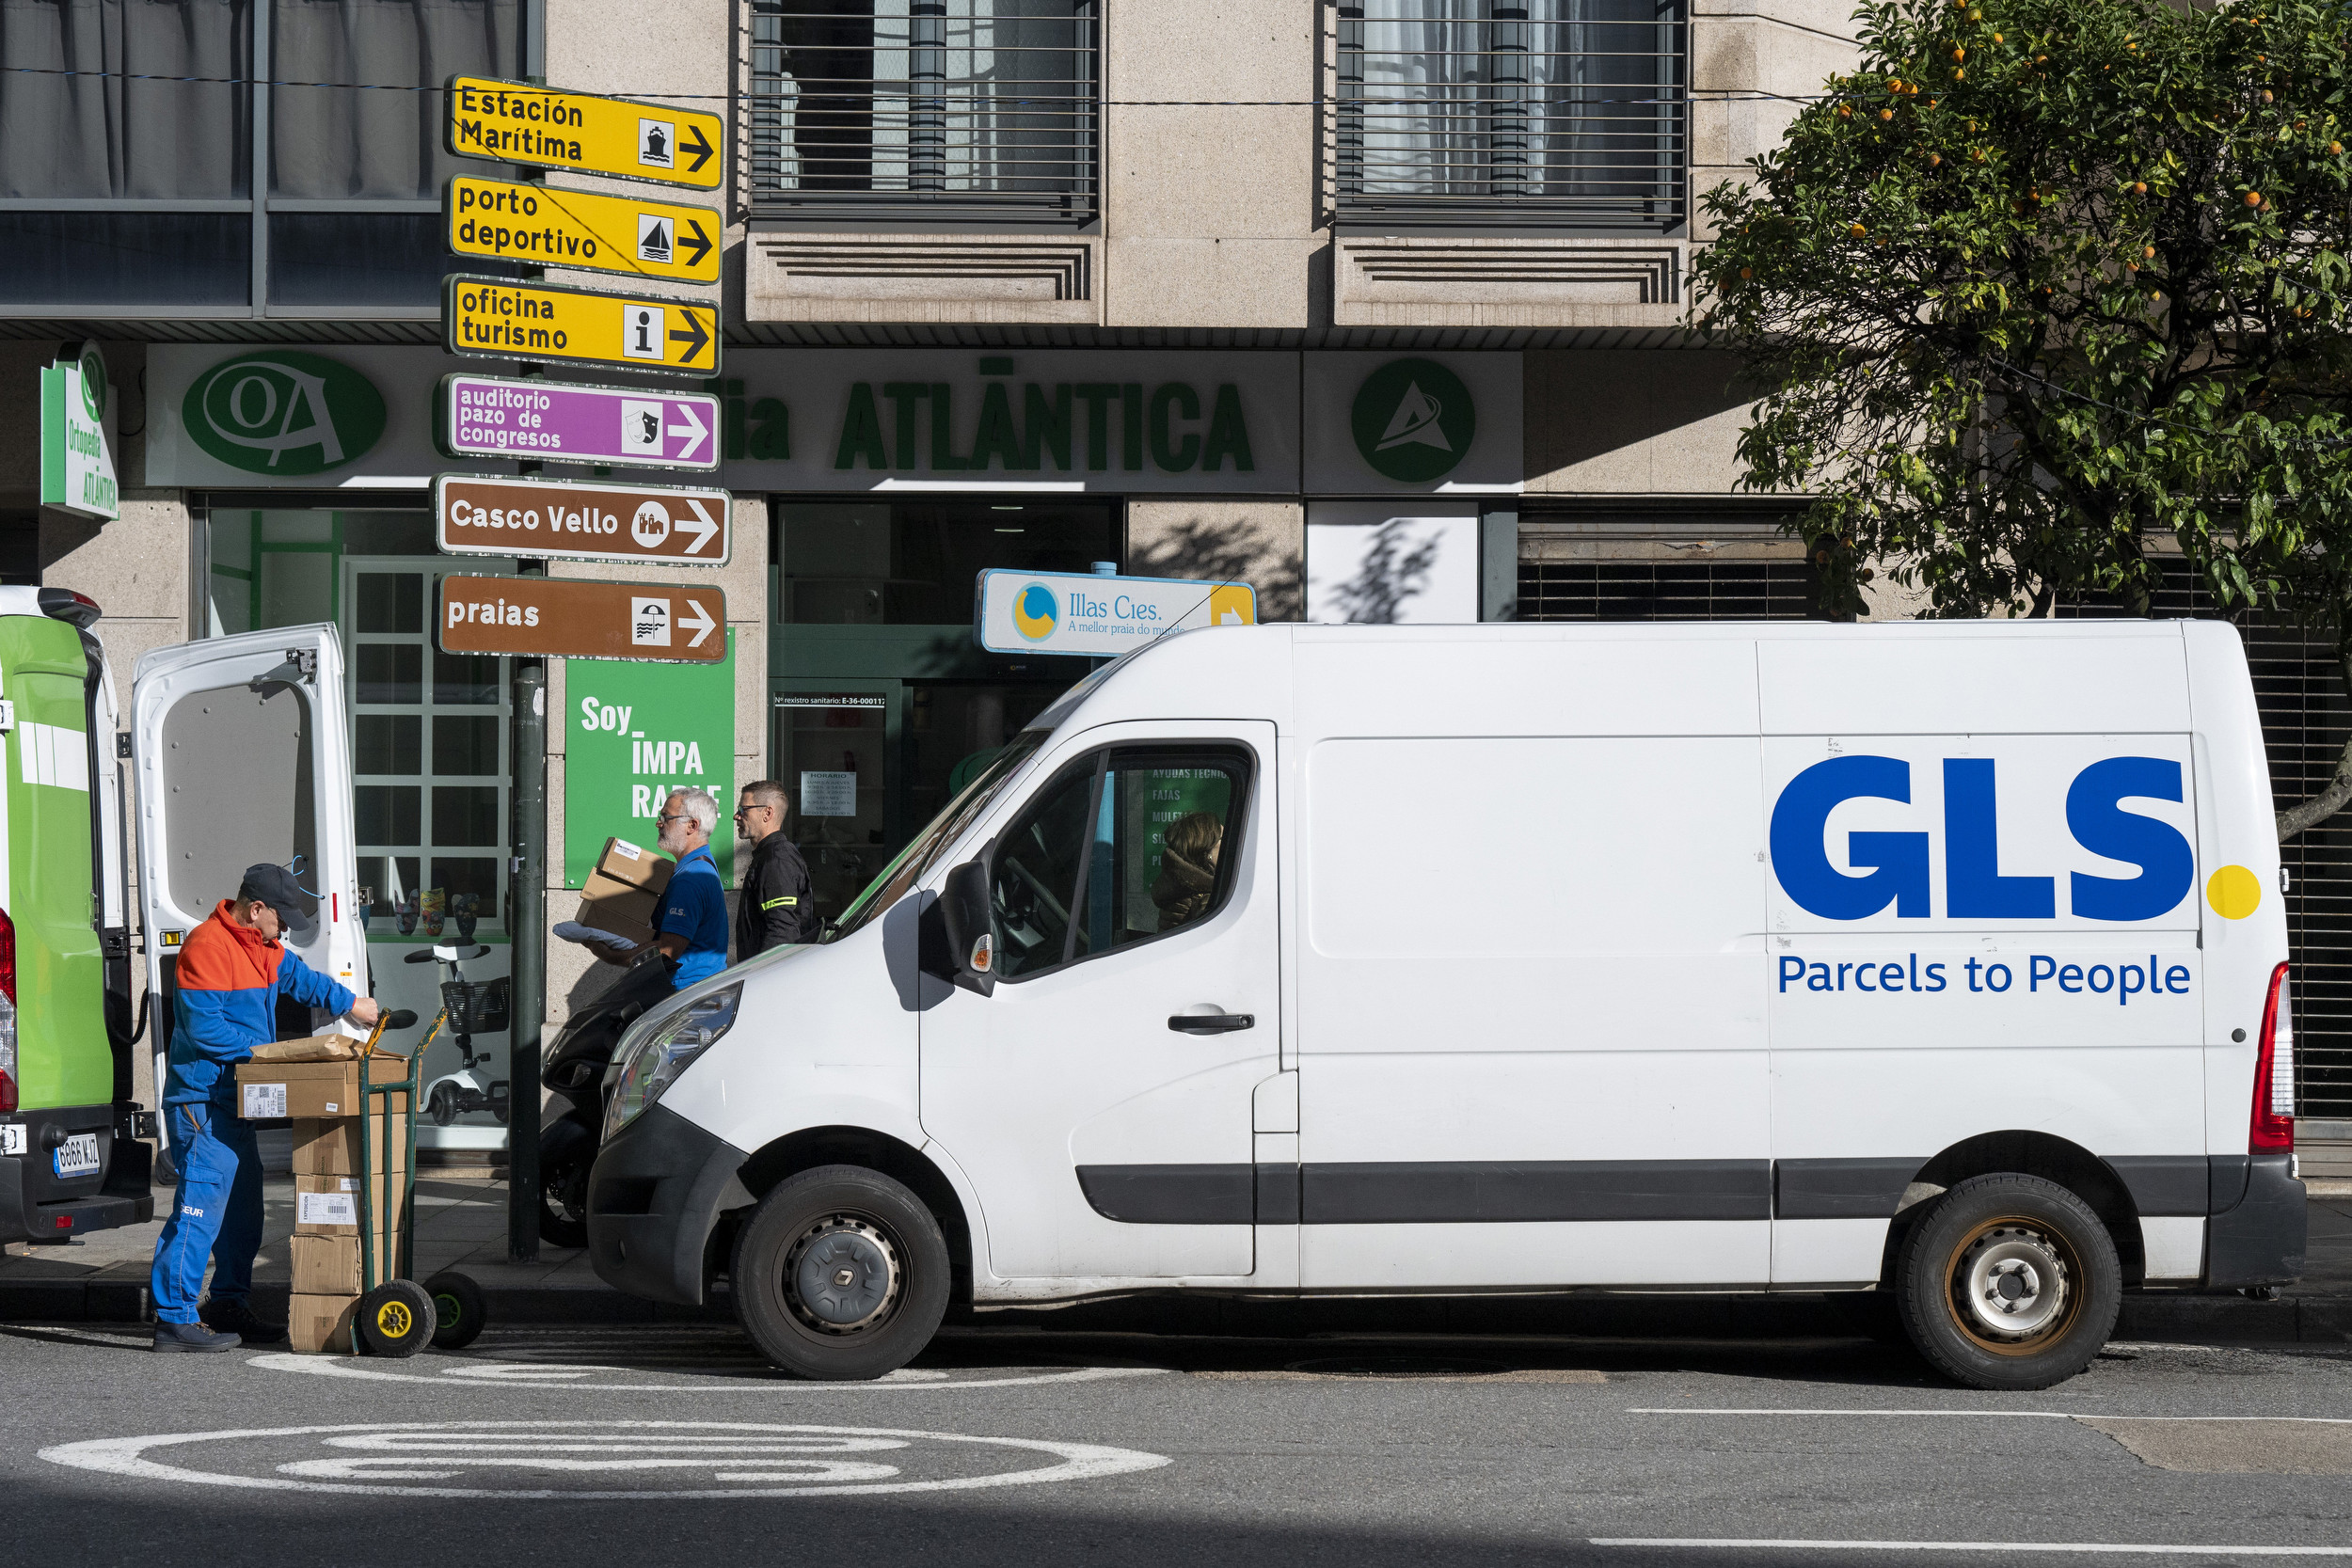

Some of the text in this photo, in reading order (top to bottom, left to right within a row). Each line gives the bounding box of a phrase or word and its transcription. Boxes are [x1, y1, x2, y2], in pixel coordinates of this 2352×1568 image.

[461, 86, 582, 127] Estación
[460, 119, 582, 161] Marítima
[459, 186, 537, 216] porto
[459, 218, 596, 259] deportivo
[462, 288, 555, 320] oficina
[462, 316, 567, 349] turismo
[460, 388, 550, 410] auditorio
[460, 405, 542, 428] pazo de
[69, 419, 101, 461] Ortopedia
[460, 426, 561, 449] congresos
[450, 499, 618, 534] Casco Vello
[448, 598, 540, 629] praias
[1069, 593, 1107, 618] Illas
[1068, 620, 1076, 632] A
[1079, 622, 1110, 633] mellor
[1111, 624, 1135, 636] praia
[1137, 623, 1150, 635] do
[1152, 768, 1190, 779] AYUDAS
[631, 784, 722, 818] RAE
[1152, 789, 1181, 800] FAJAS
[1778, 953, 2191, 1006] Parcels to People
